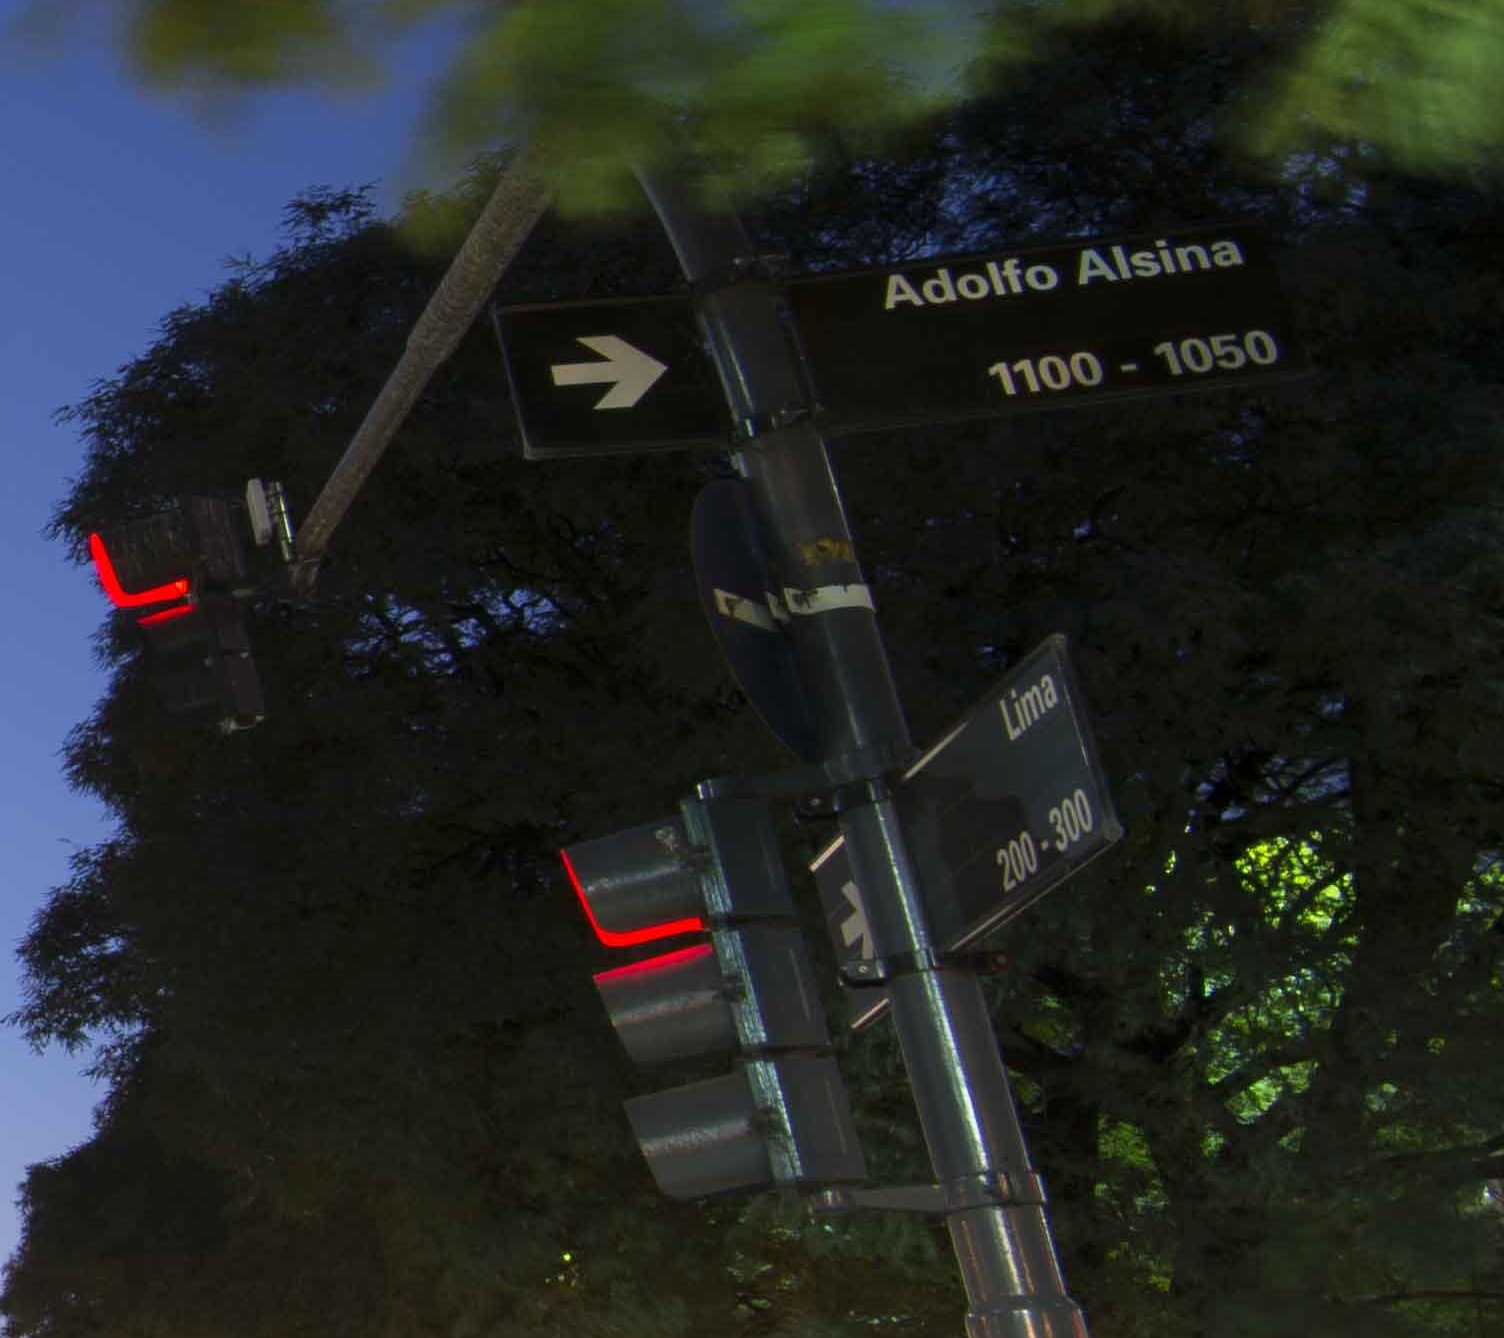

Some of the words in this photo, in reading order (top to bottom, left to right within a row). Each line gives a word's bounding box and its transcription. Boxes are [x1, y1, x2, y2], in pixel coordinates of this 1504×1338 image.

[884, 258, 1060, 310] Adolfo
[1077, 238, 1245, 286] Alsina
[989, 351, 1105, 396] 1100
[1154, 330, 1280, 375] 1050
[999, 673, 1059, 742] Lima
[996, 829, 1038, 892] 200
[1048, 787, 1094, 854] 300
